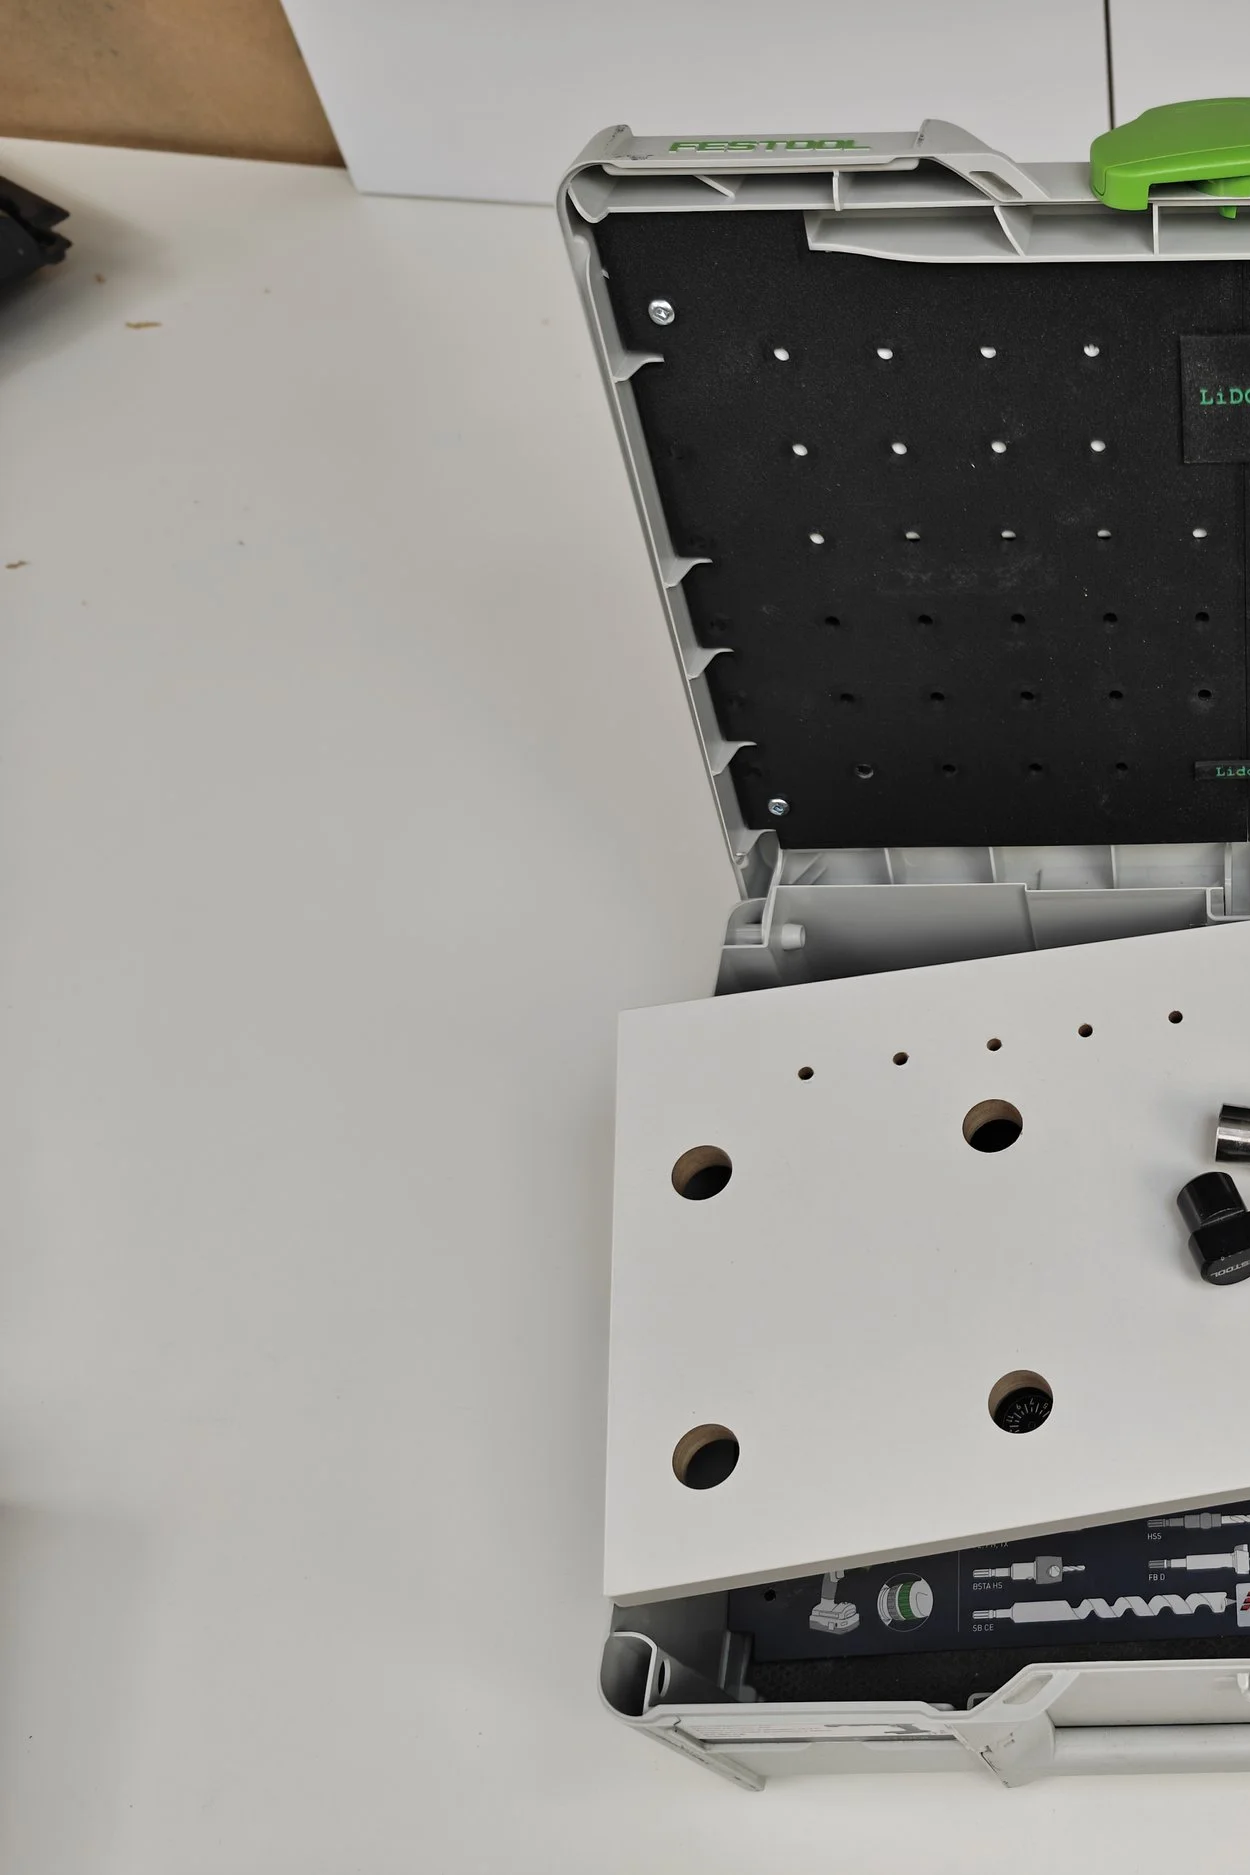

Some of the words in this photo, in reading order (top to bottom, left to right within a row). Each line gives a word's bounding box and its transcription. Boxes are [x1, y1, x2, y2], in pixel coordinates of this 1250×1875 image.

[669, 140, 871, 152] FESTOOL
[1147, 1532, 1162, 1540] HSS
[1148, 1573, 1158, 1581] FB
[972, 1582, 991, 1591] BSTA
[992, 1581, 1003, 1590] HS
[972, 1624, 982, 1632] SB
[984, 1623, 994, 1632] CE
